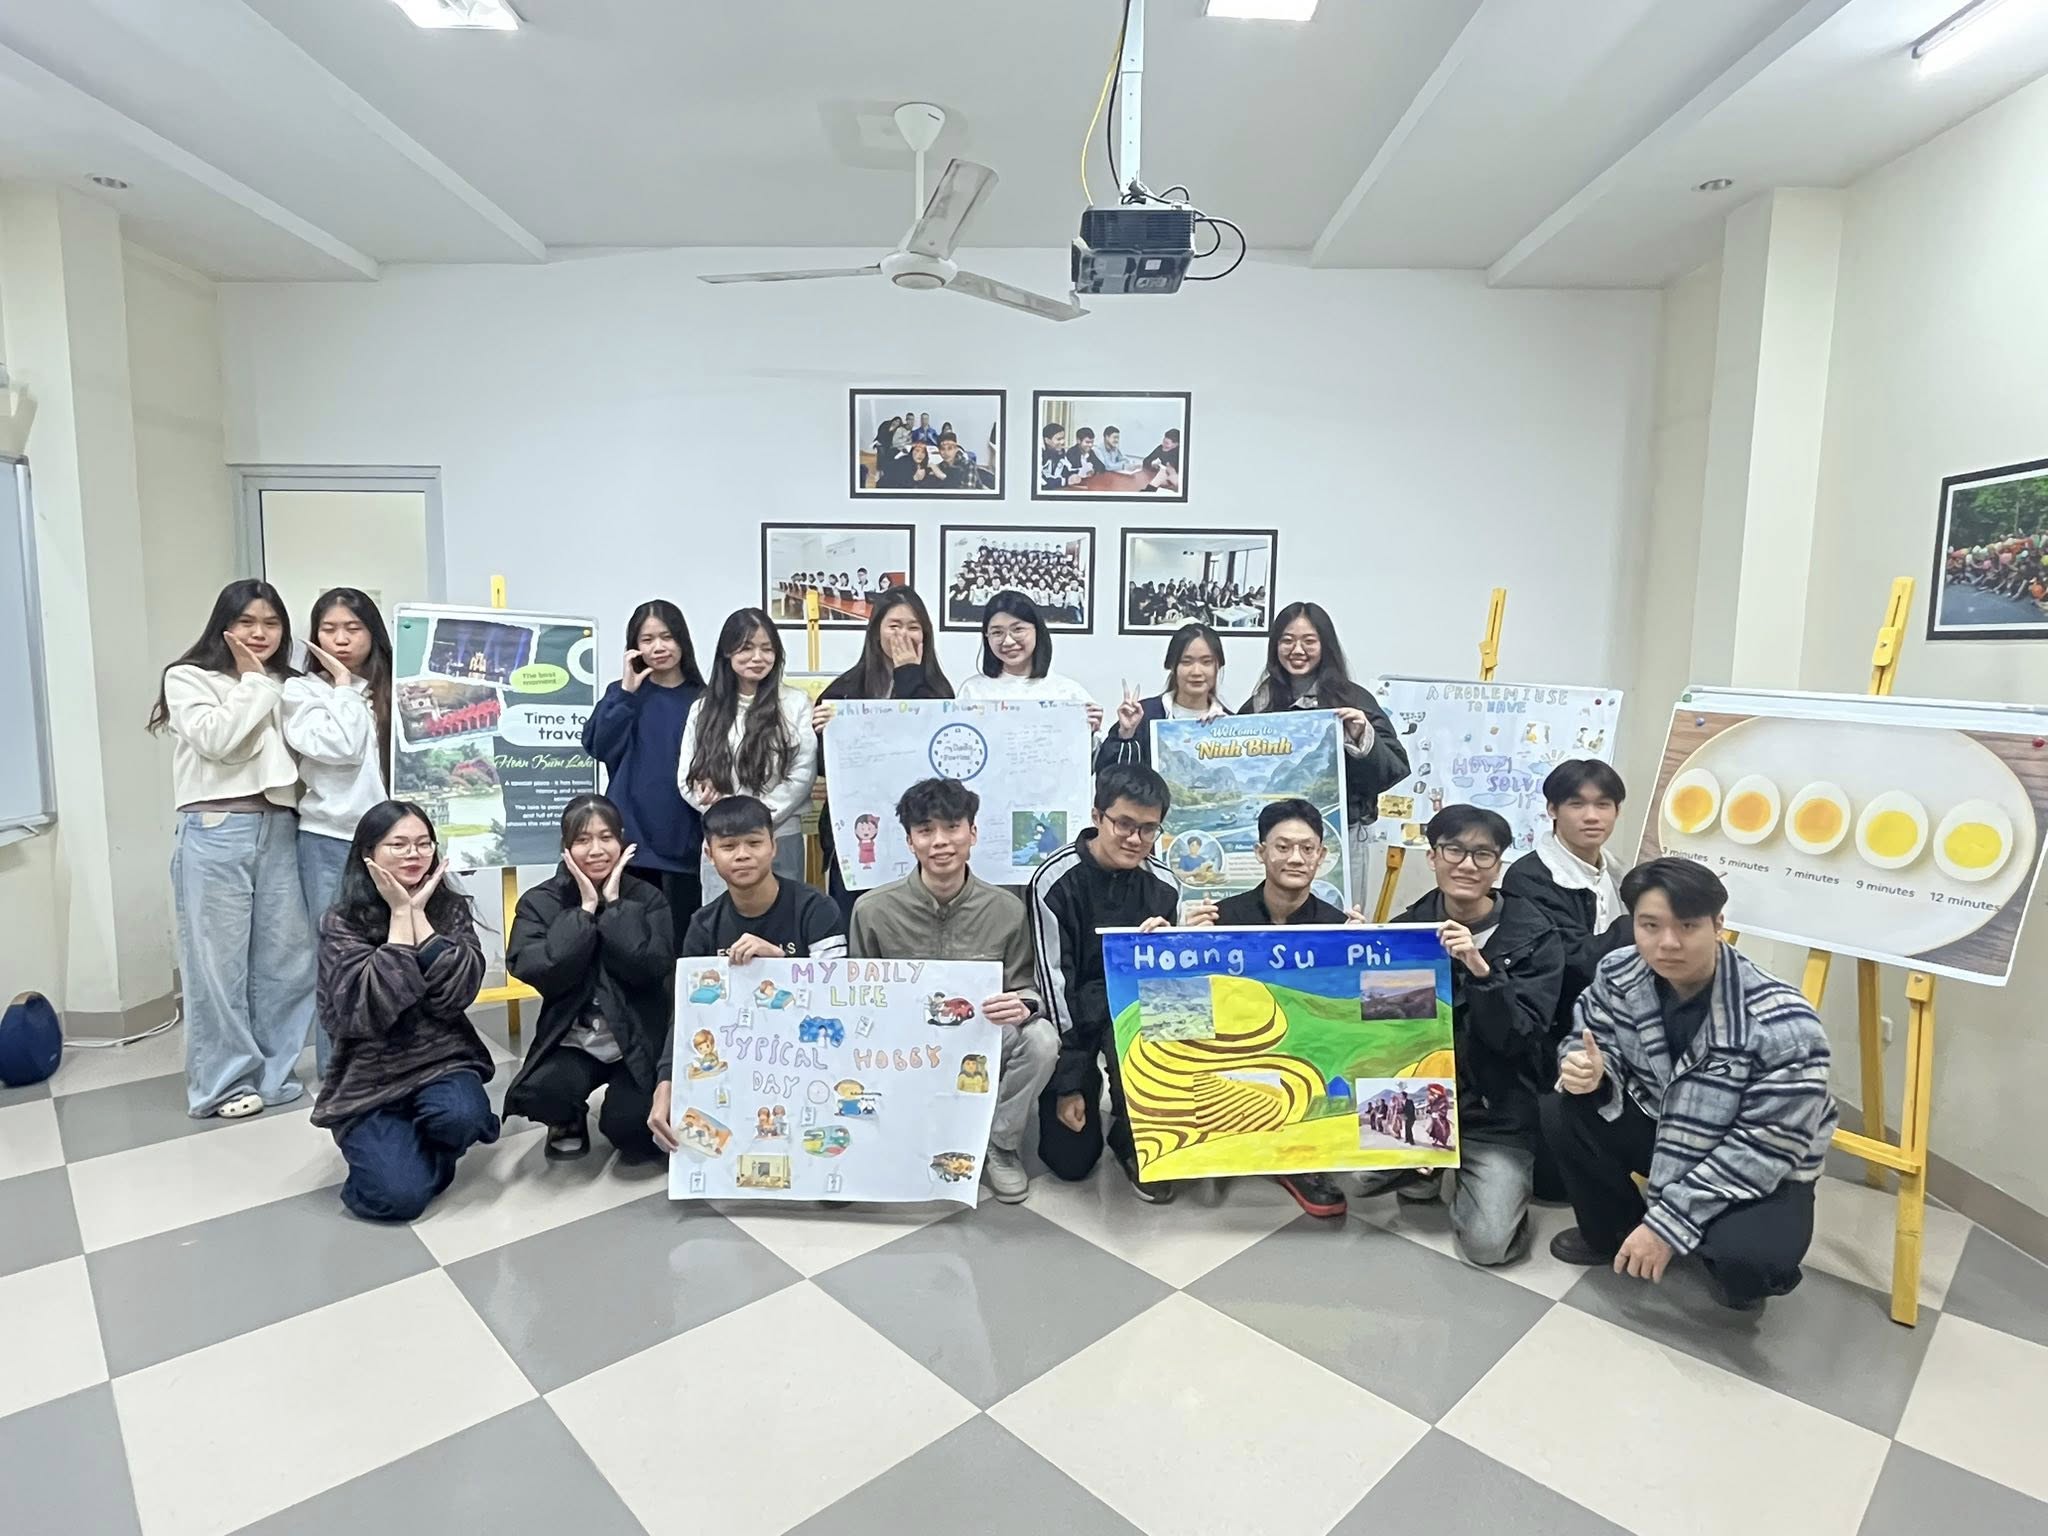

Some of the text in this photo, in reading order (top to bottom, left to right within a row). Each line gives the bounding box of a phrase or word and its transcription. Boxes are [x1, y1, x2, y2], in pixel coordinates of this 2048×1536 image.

[1425, 685, 1440, 702] A
[1443, 684, 1519, 702] PROBLEM
[1534, 689, 1570, 706] USE
[1467, 700, 1527, 714] TO HAVE
[524, 712, 588, 725] Time to
[538, 727, 583, 740] trave
[1210, 724, 1274, 738] Welcome to
[1195, 737, 1294, 760] Ninh Binh
[1452, 757, 1507, 775] HOW
[1669, 848, 1709, 863] minutes
[1718, 856, 1770, 873] 5 minutes
[1784, 867, 1841, 885] 7 minutes
[1856, 880, 1916, 898] 9 minutes
[1929, 892, 2002, 913] 12 minutes
[1134, 945, 1244, 976] Hoang
[1269, 945, 1315, 969] Su
[791, 961, 925, 984] MY DAILY
[853, 1044, 943, 1071] HOBBY
[752, 1070, 801, 1099] DAY
